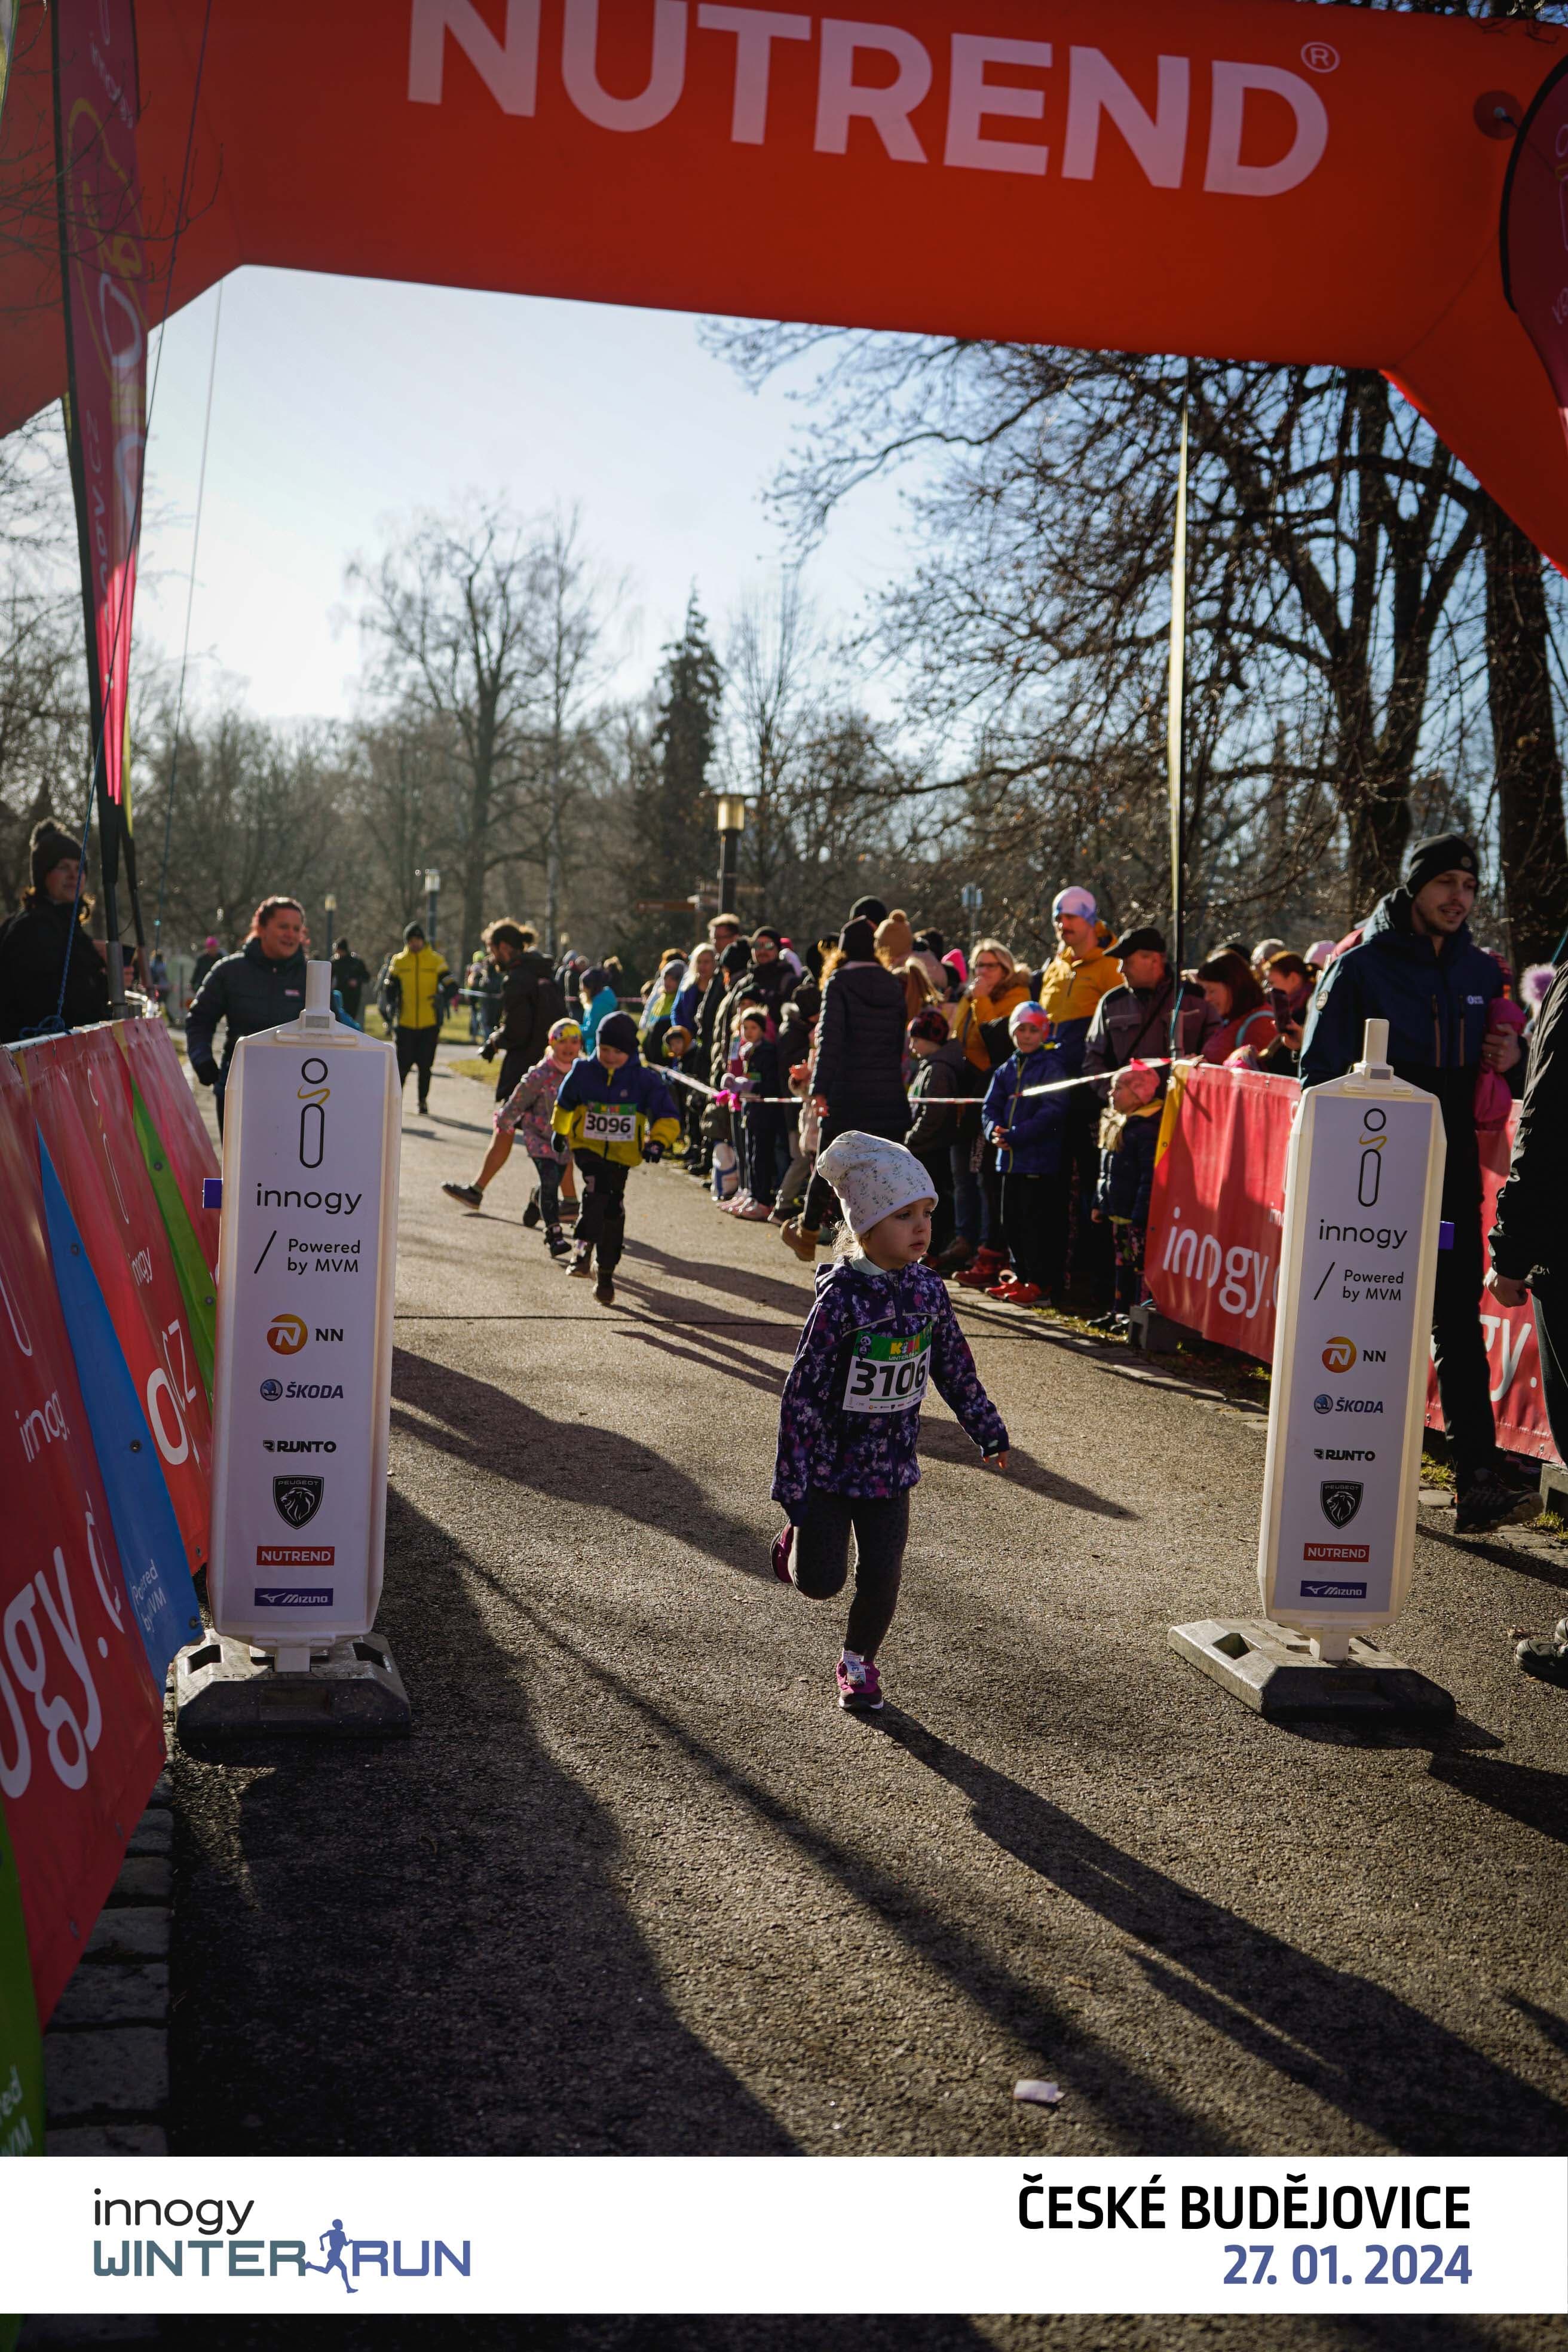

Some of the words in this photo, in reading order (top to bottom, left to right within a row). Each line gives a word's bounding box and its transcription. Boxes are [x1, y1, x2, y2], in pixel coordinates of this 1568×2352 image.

[408, 0, 1329, 197] NUTREND
[586, 1114, 631, 1133] 3096
[256, 1183, 362, 1215] innogy
[1318, 1218, 1408, 1250] innogy
[288, 1238, 361, 1255] Powered
[287, 1257, 308, 1275] by
[315, 1258, 359, 1273] MVM
[1343, 1269, 1404, 1285] Powered
[1342, 1286, 1360, 1303] by
[1365, 1288, 1402, 1301] MVM
[315, 1328, 344, 1343] NN
[1362, 1349, 1387, 1363] NN
[850, 1352, 927, 1396] 3106
[285, 1381, 344, 1399] ŠKODA
[1334, 1396, 1384, 1414] ŠKODA
[277, 1440, 337, 1453] RUNTO
[1325, 1448, 1376, 1462] RUNTO
[261, 1550, 332, 1563] NUTREND
[1307, 1546, 1367, 1559] NUTREND
